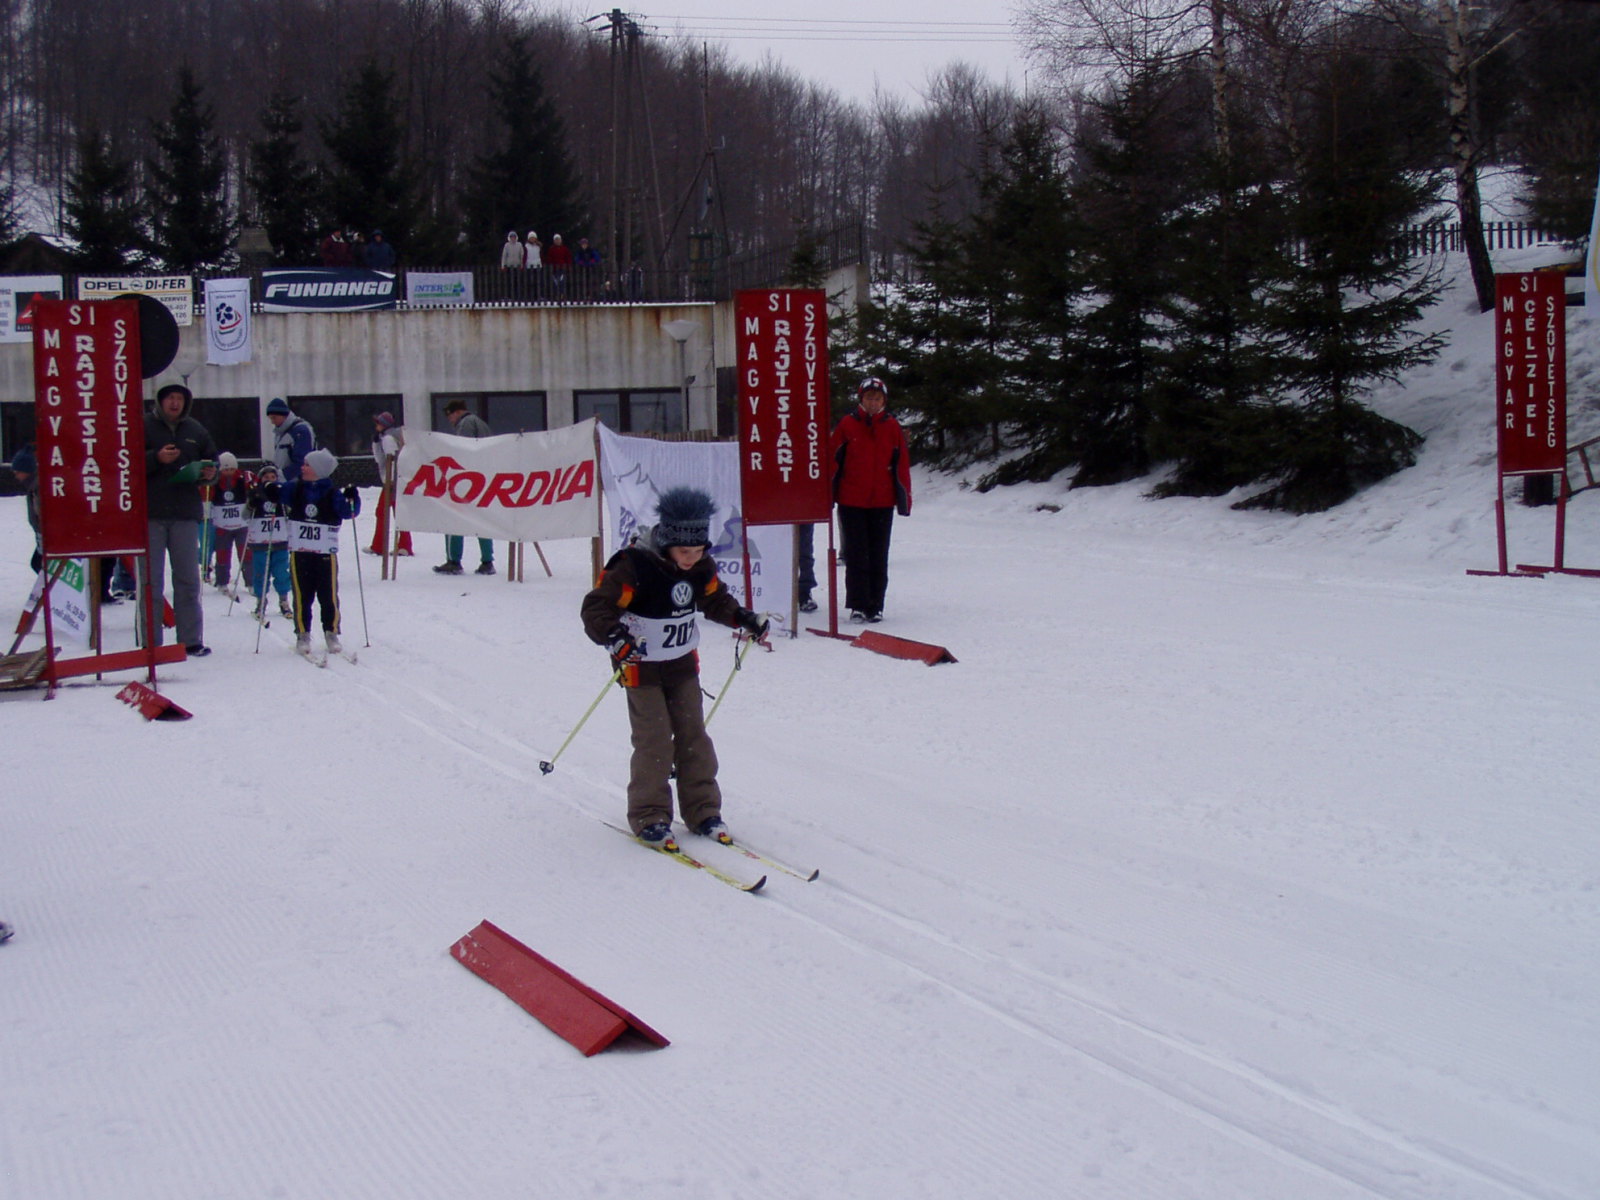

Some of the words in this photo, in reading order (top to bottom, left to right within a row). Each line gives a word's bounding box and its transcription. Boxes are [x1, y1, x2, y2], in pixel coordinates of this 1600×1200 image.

[84, 281, 128, 291] OPEL
[265, 281, 393, 298] FUNDANGO
[1503, 296, 1514, 429] MAGYAR
[745, 316, 763, 471] MAGYAR
[43, 328, 66, 497] MAGYAR
[403, 456, 595, 508] NORDICA
[222, 507, 240, 519] 205
[261, 520, 281, 533] 204
[299, 525, 321, 541] 203
